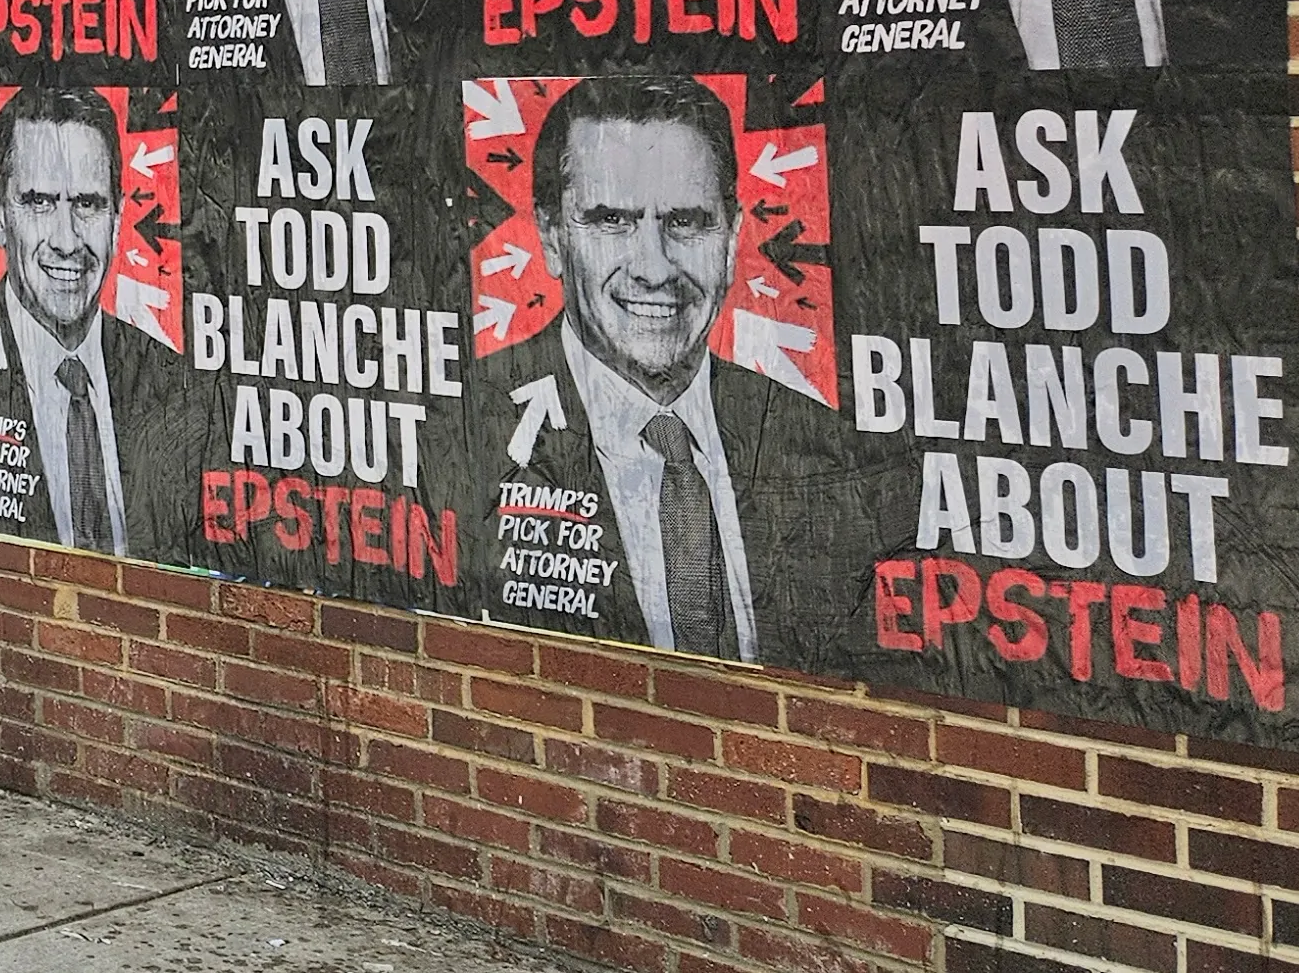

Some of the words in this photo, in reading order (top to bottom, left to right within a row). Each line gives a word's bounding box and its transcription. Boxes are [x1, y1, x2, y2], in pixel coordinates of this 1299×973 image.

[187, 13, 281, 41] ATTORNEY
[188, 42, 267, 69] GENERAL
[841, 18, 966, 53] GENERAL
[257, 117, 375, 201] ASK
[953, 109, 1145, 214] ASK
[236, 207, 390, 295] TODD
[919, 225, 1171, 335] TODD
[192, 292, 463, 398] BLANCHE
[230, 385, 427, 489] ABOUT
[851, 334, 1290, 467] BLANCHE
[0, 443, 31, 468] FOR
[202, 469, 459, 588] EPSTEIN
[497, 514, 549, 546] PICK
[557, 520, 604, 552] FOR
[499, 482, 599, 518] TRUMP'S
[915, 453, 1229, 583] ABOUT
[500, 547, 618, 586] ATTORNEY
[502, 581, 600, 619] GENERAL
[875, 558, 1286, 712] EPSTEIN
